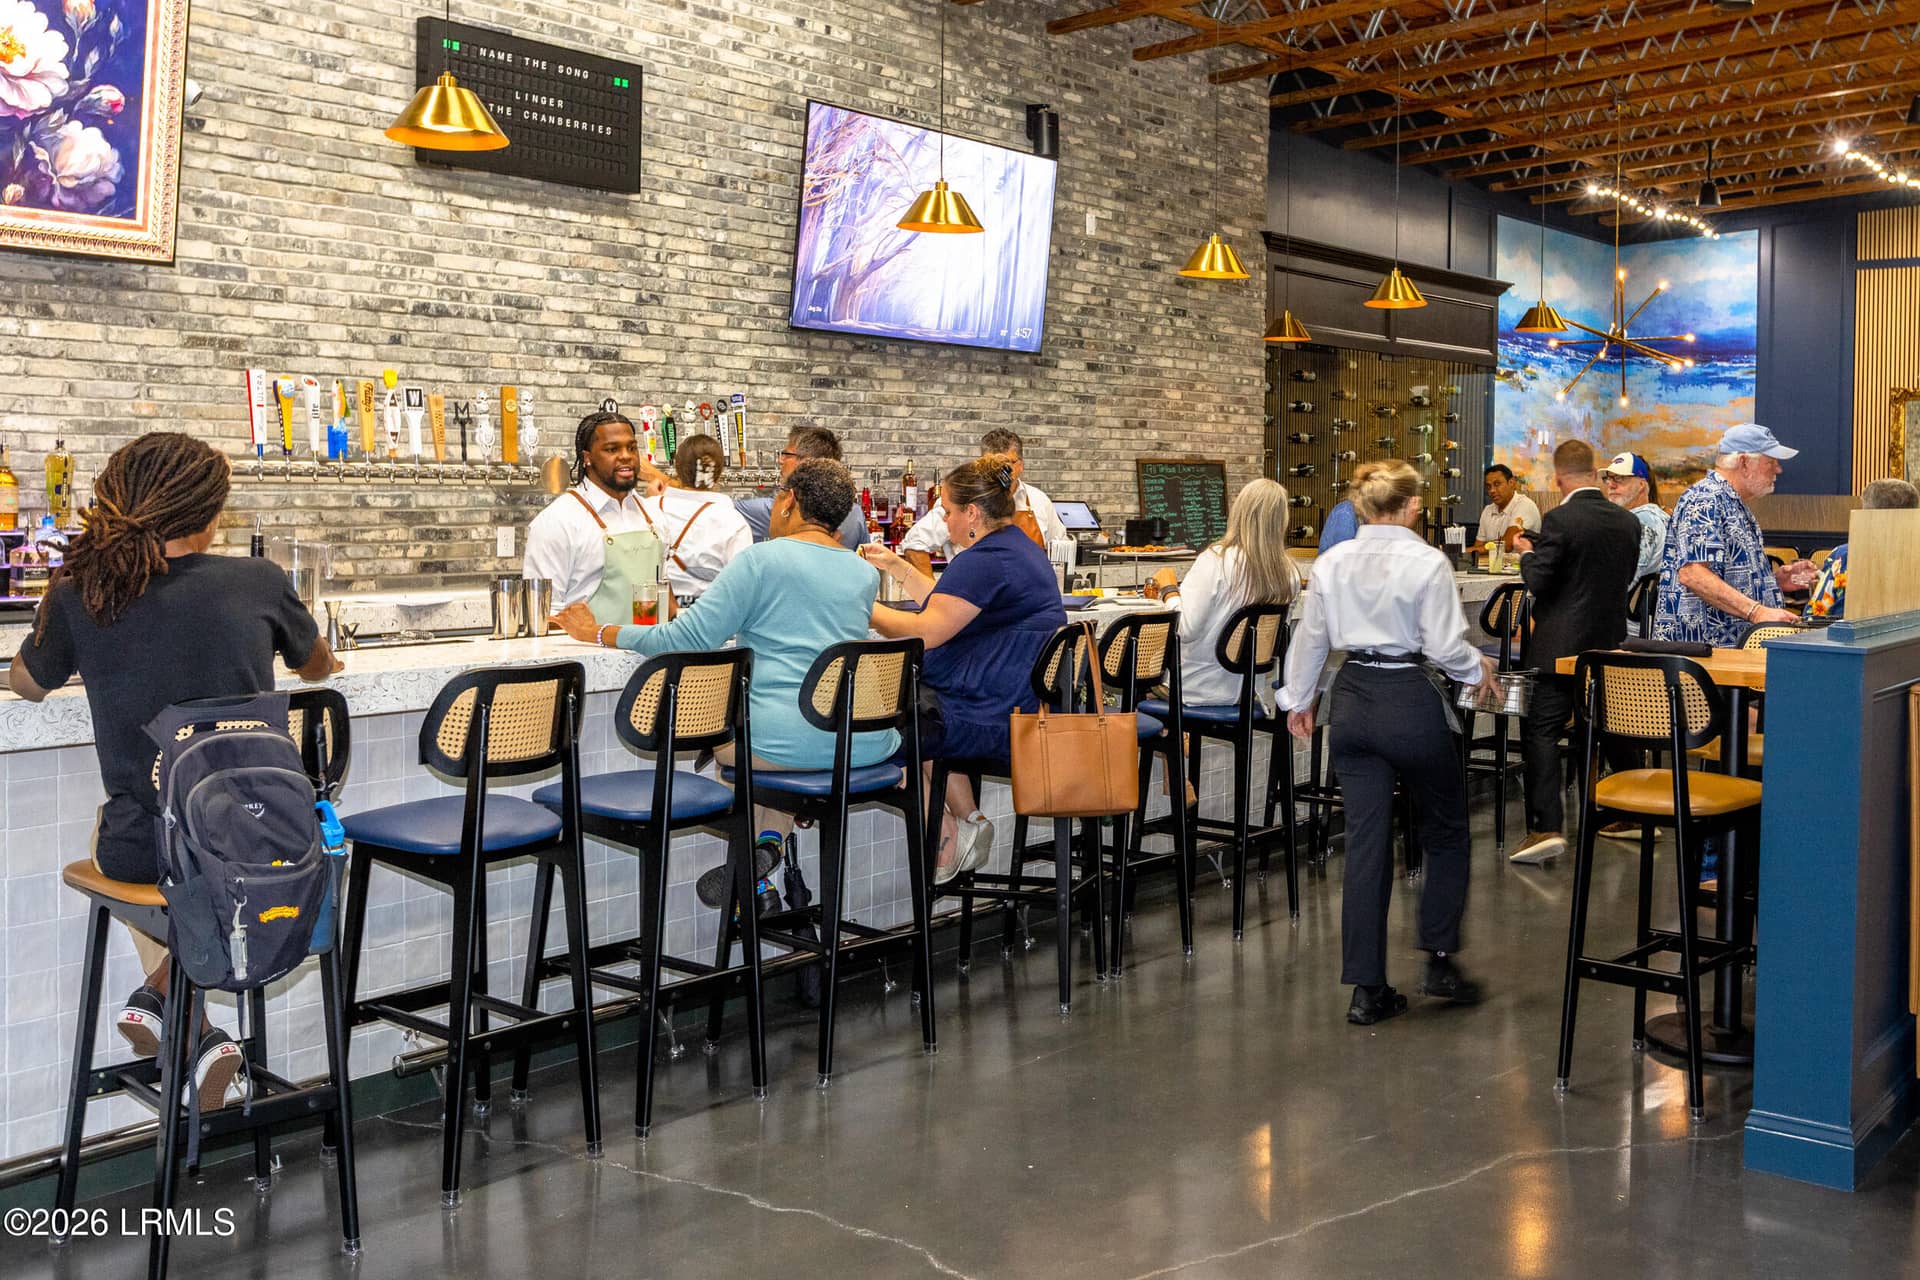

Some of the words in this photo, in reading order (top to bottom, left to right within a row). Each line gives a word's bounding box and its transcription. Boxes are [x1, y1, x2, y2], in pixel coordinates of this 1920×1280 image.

[479, 47, 513, 62] NAME
[525, 57, 547, 70] THE
[558, 65, 589, 79] SONG
[515, 91, 564, 108] LINGER
[489, 103, 513, 116] THE
[523, 110, 613, 136] CRANBERRIES
[256, 374, 265, 402] ULTRA
[312, 403, 320, 419] lite
